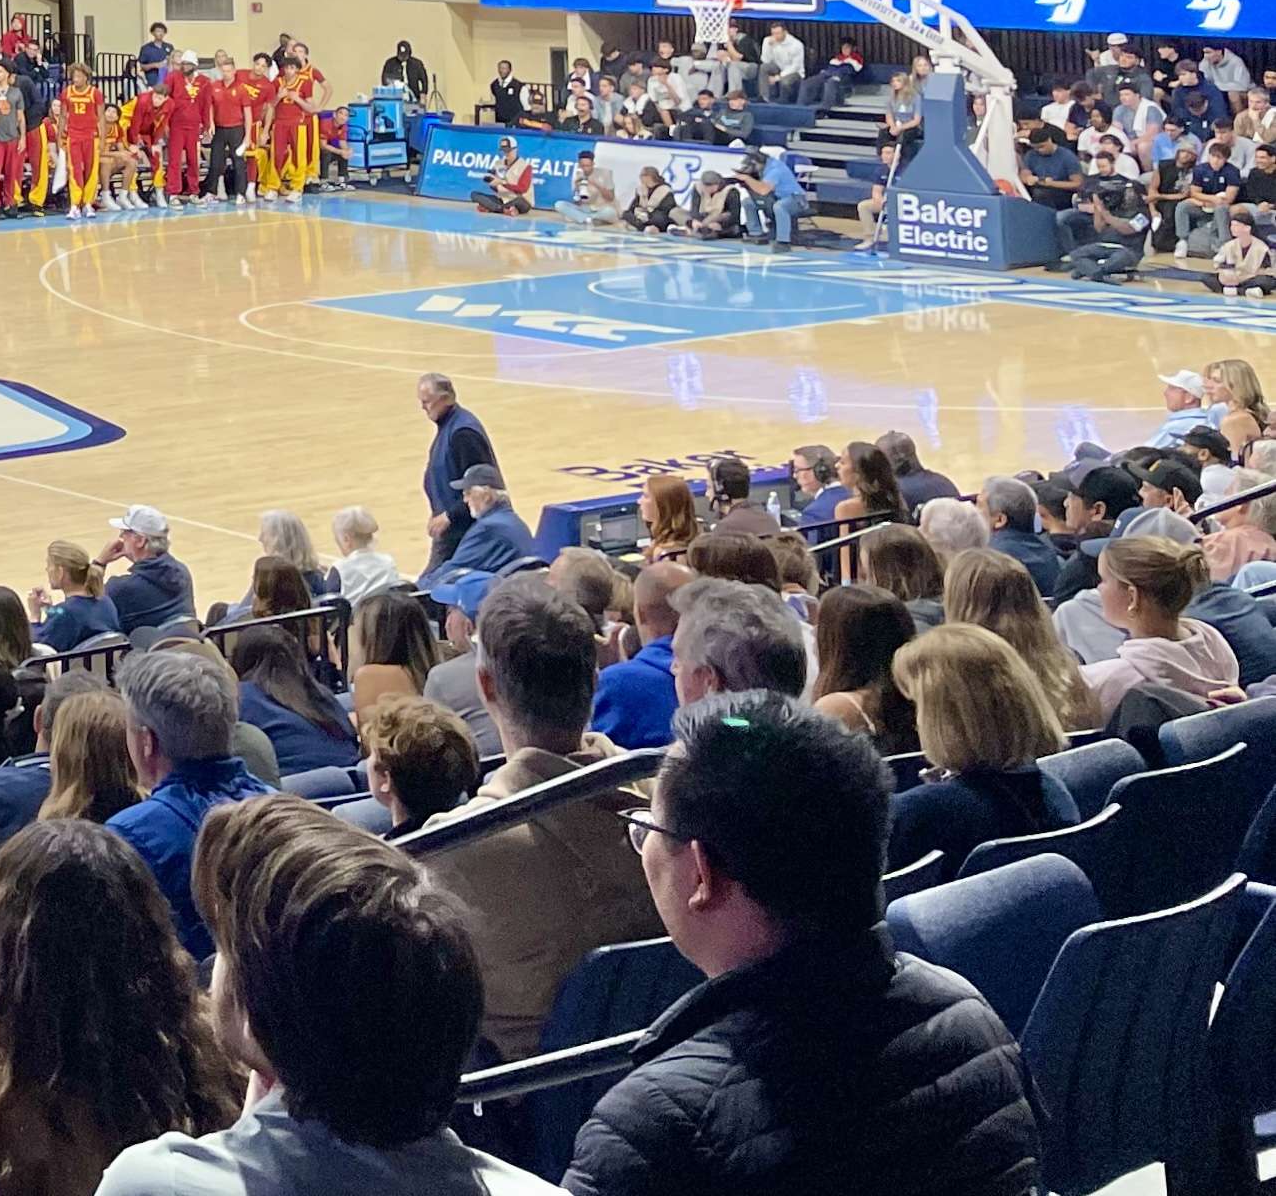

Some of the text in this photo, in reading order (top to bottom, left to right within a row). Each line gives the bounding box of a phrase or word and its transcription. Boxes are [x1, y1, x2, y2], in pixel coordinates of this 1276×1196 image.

[432, 149, 507, 170] PALOMA
[897, 193, 987, 229] Baker
[898, 224, 988, 252] Electric
